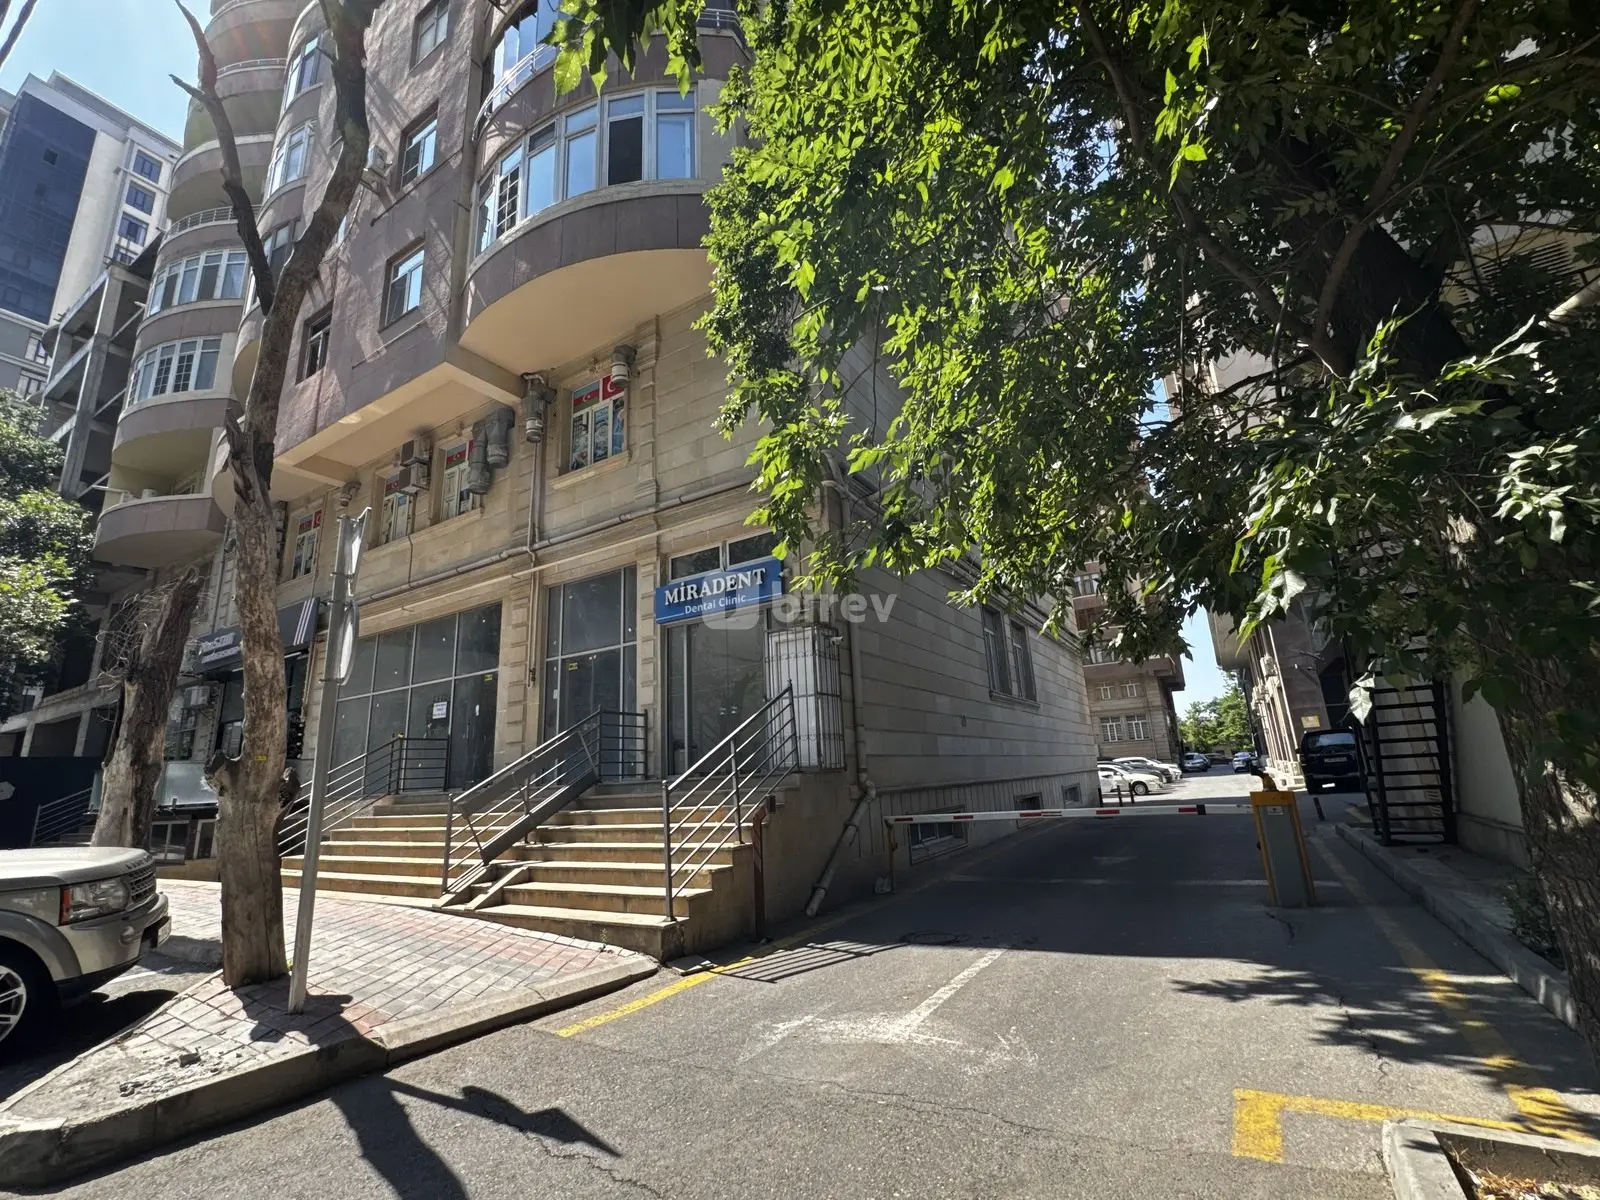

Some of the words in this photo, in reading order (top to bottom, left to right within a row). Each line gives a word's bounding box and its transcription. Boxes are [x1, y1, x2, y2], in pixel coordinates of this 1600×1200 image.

[664, 567, 766, 606] MİRADENT
[684, 600, 716, 614] Dental
[718, 594, 747, 607] Clinic
